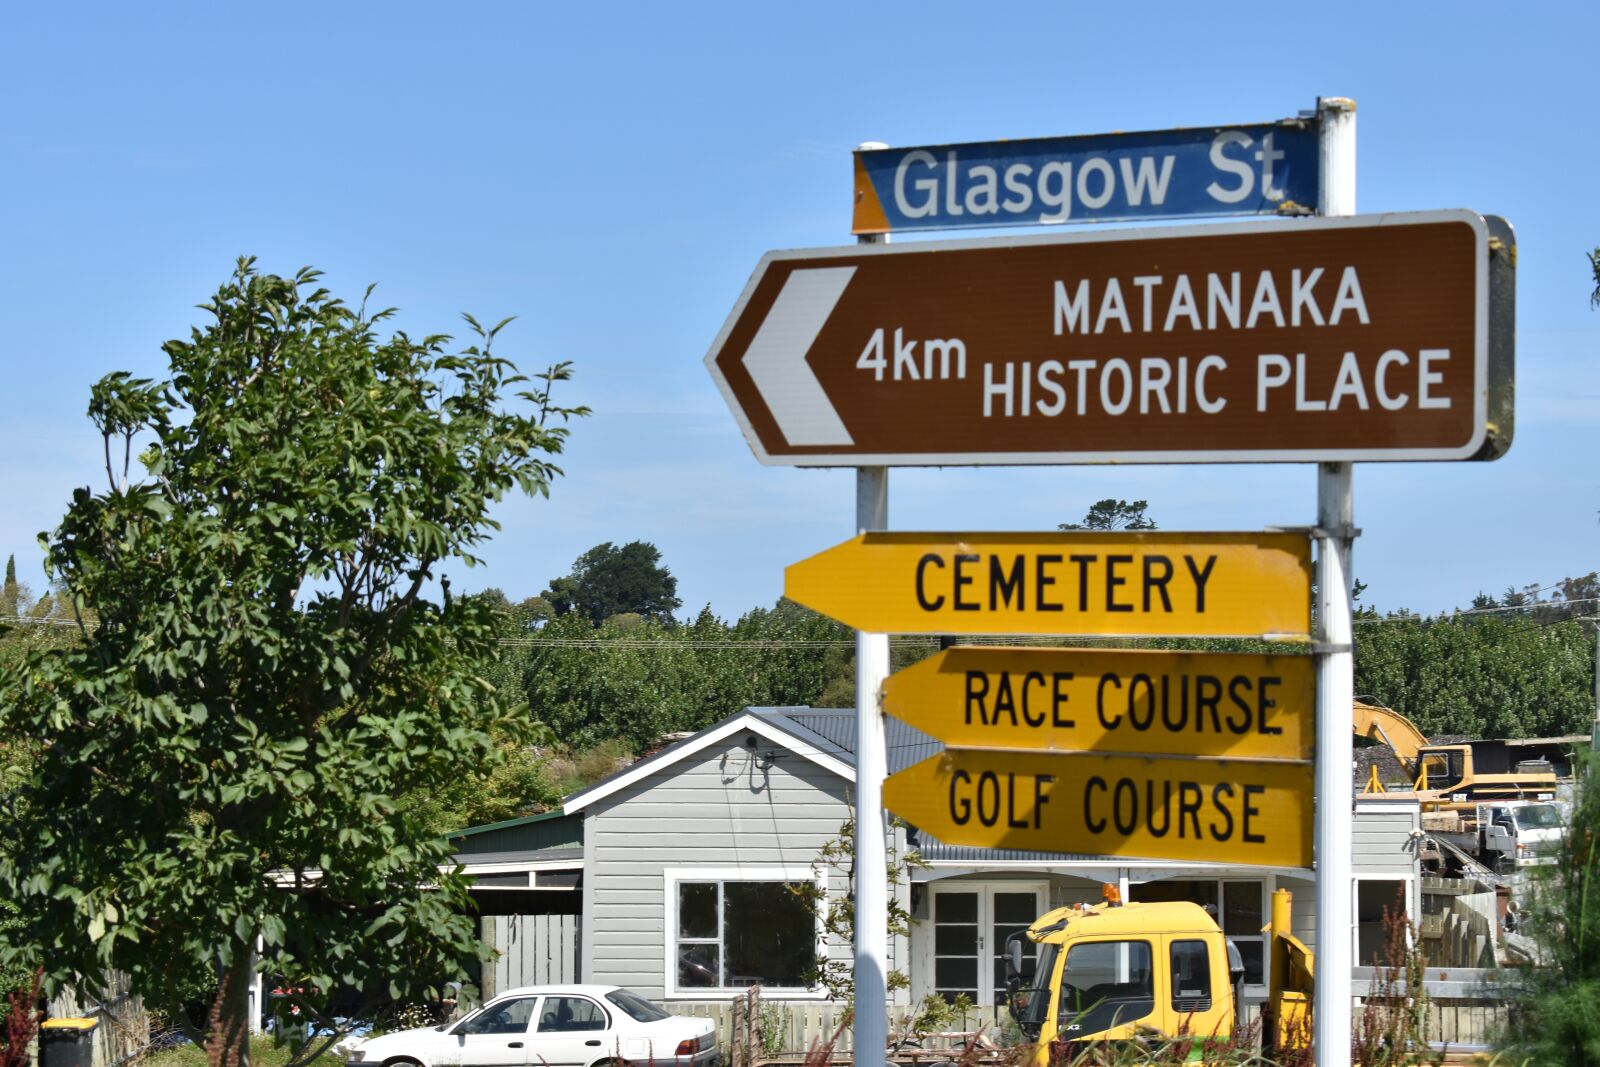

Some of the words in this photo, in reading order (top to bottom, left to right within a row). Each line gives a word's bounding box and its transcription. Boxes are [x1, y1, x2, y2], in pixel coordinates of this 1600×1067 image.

[893, 150, 1176, 225] Glasgow
[1206, 131, 1286, 203] St
[1053, 265, 1371, 336] MATANAKA
[855, 326, 967, 381] 4km
[981, 355, 1228, 418] HISTORIC
[1256, 348, 1451, 413] PLACE
[915, 553, 1218, 613] CEMETERY
[964, 669, 1076, 728] RACE
[1096, 673, 1282, 735] COURSE
[949, 769, 1055, 829] GOLF
[1083, 775, 1266, 843] COURSE
